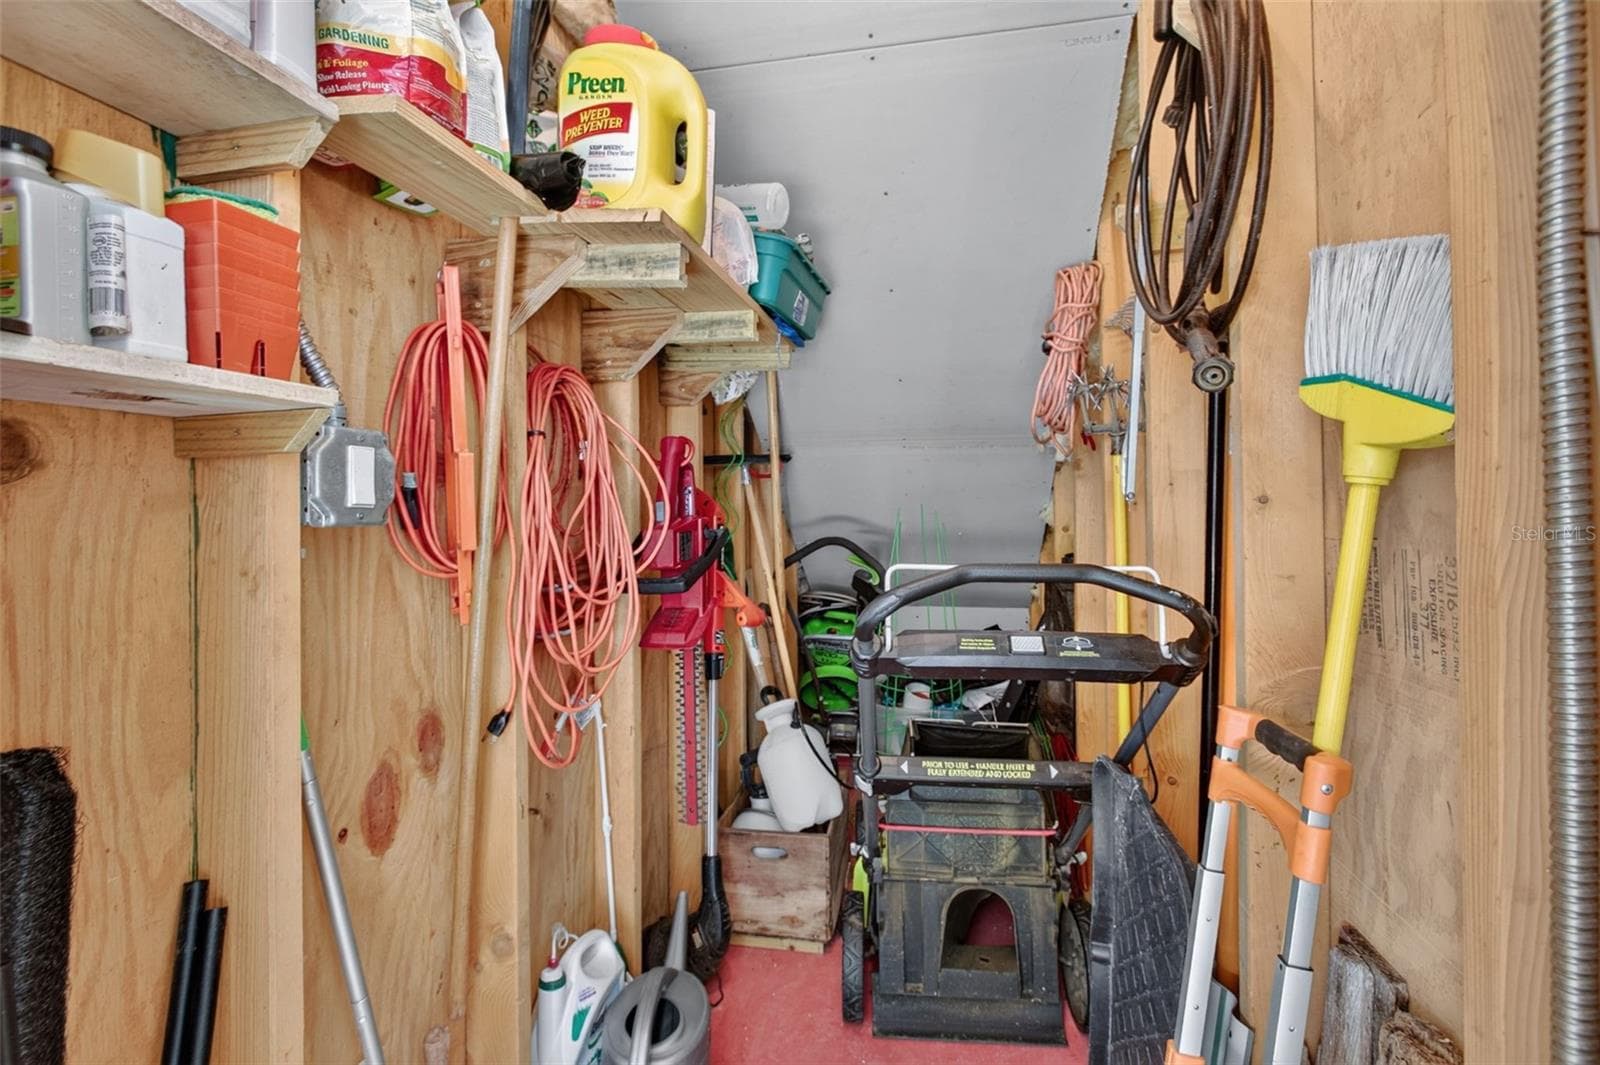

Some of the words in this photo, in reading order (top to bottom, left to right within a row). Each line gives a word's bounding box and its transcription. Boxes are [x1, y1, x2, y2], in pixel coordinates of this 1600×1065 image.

[318, 28, 389, 49] GARDENING
[332, 58, 369, 69] Foliage
[335, 70, 367, 79] Release
[567, 72, 624, 94] Preen
[579, 107, 610, 122] WEED
[565, 117, 623, 142] PREVENTER
[1428, 579, 1439, 641] EXPOSURE
[1440, 627, 1448, 675] SPACING
